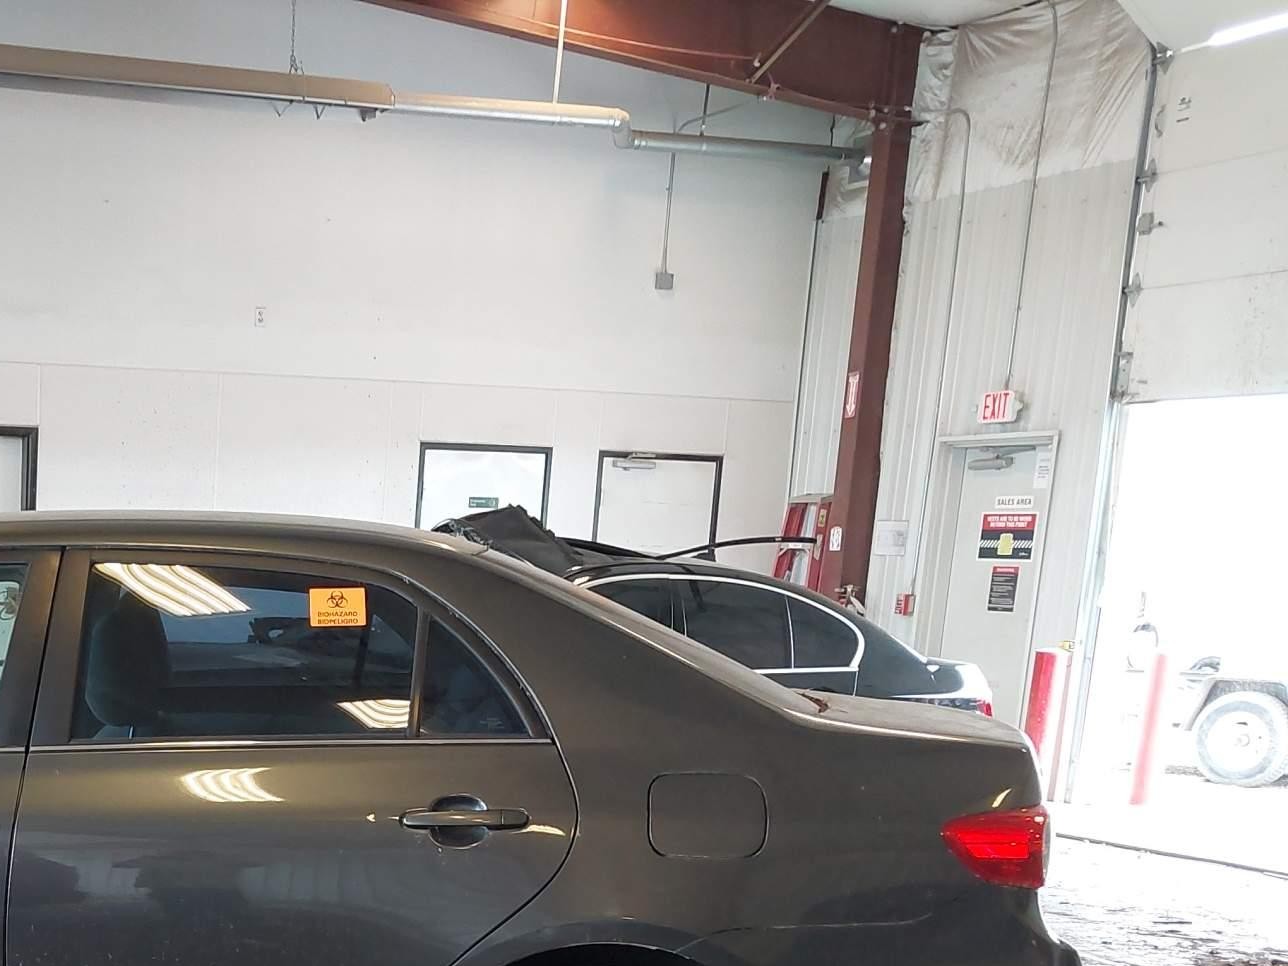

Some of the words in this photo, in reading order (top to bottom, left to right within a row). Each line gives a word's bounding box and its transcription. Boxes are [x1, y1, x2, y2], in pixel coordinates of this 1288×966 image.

[982, 392, 1010, 420] EXIT
[997, 498, 1015, 506] SALES
[1016, 498, 1032, 506] AREA
